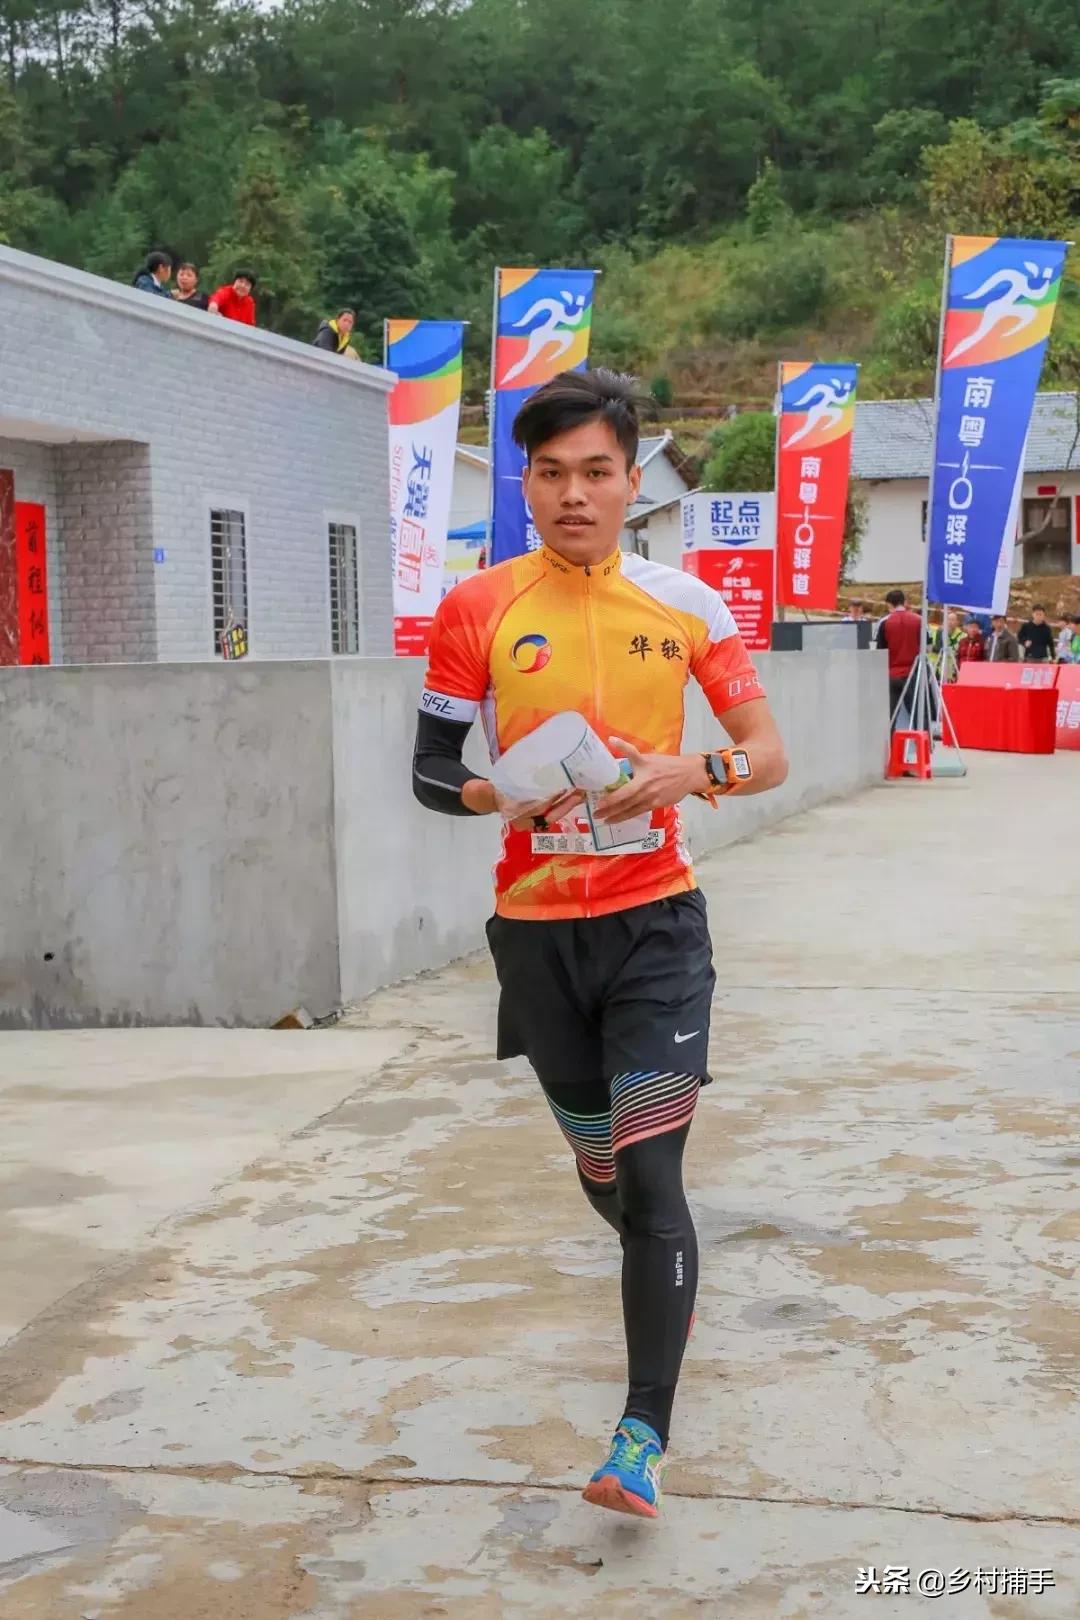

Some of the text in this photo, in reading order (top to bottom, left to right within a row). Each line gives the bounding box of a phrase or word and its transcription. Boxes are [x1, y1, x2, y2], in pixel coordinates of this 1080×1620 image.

[711, 501, 760, 523] 起点
[712, 526, 760, 536] START
[628, 634, 683, 661] 华软
